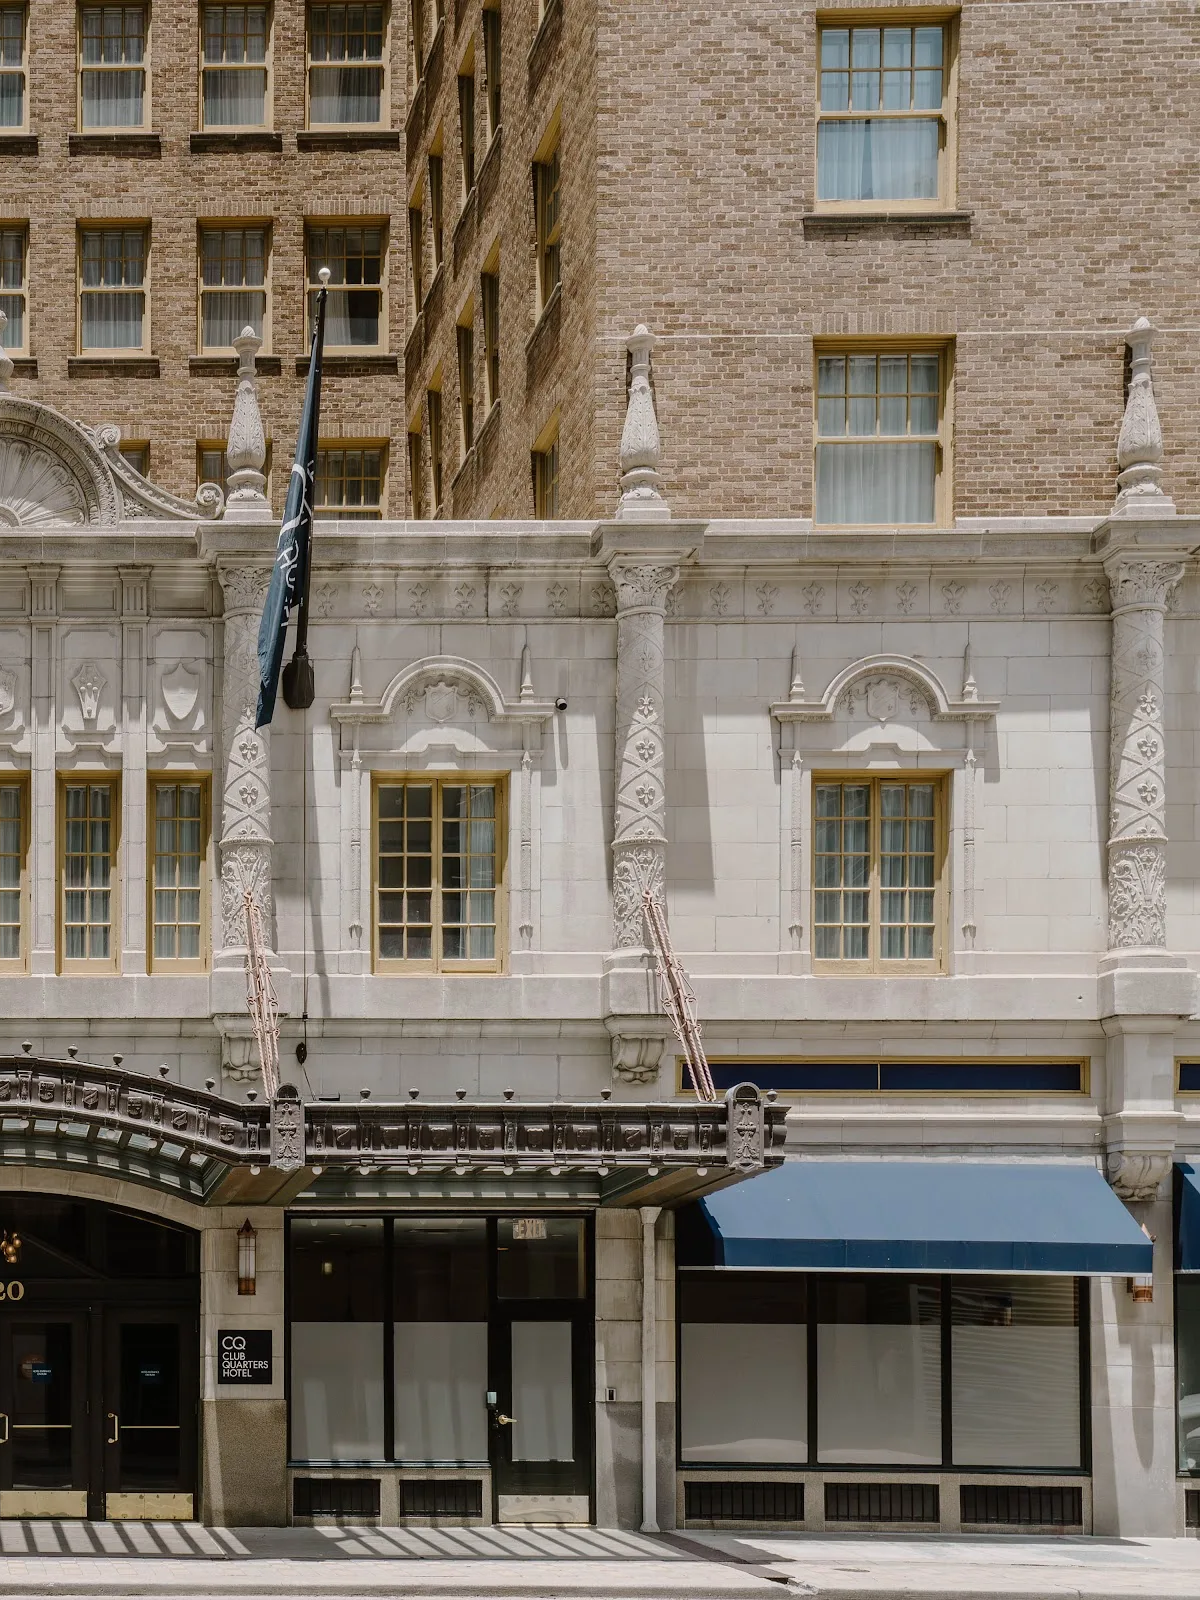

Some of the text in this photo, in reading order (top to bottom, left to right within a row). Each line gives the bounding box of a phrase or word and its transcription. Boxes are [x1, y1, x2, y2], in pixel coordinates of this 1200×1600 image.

[222, 1336, 246, 1350] CQ
[222, 1352, 246, 1361] CLUB
[222, 1360, 269, 1369] QUARTERS
[222, 1368, 252, 1378] HOTEL
